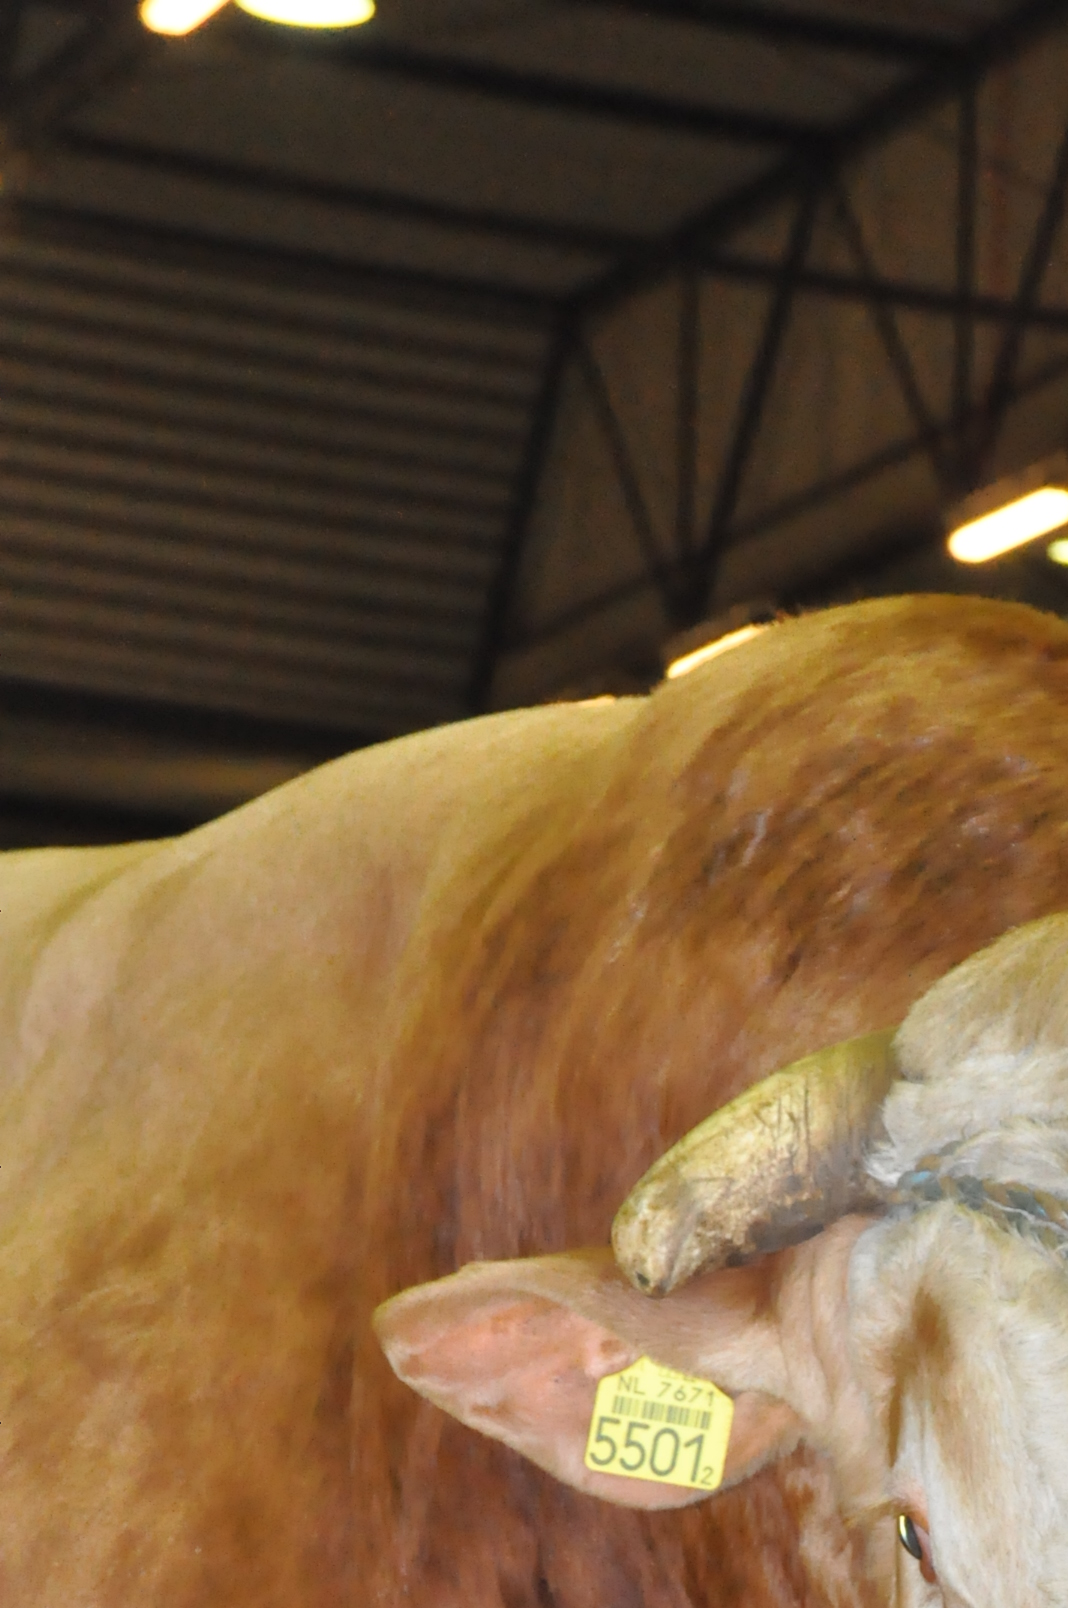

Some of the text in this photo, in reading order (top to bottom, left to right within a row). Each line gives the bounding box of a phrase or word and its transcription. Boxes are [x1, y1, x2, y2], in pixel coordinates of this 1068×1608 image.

[617, 1375, 714, 1406] NL 7671
[590, 1416, 713, 1485] 5501 2
